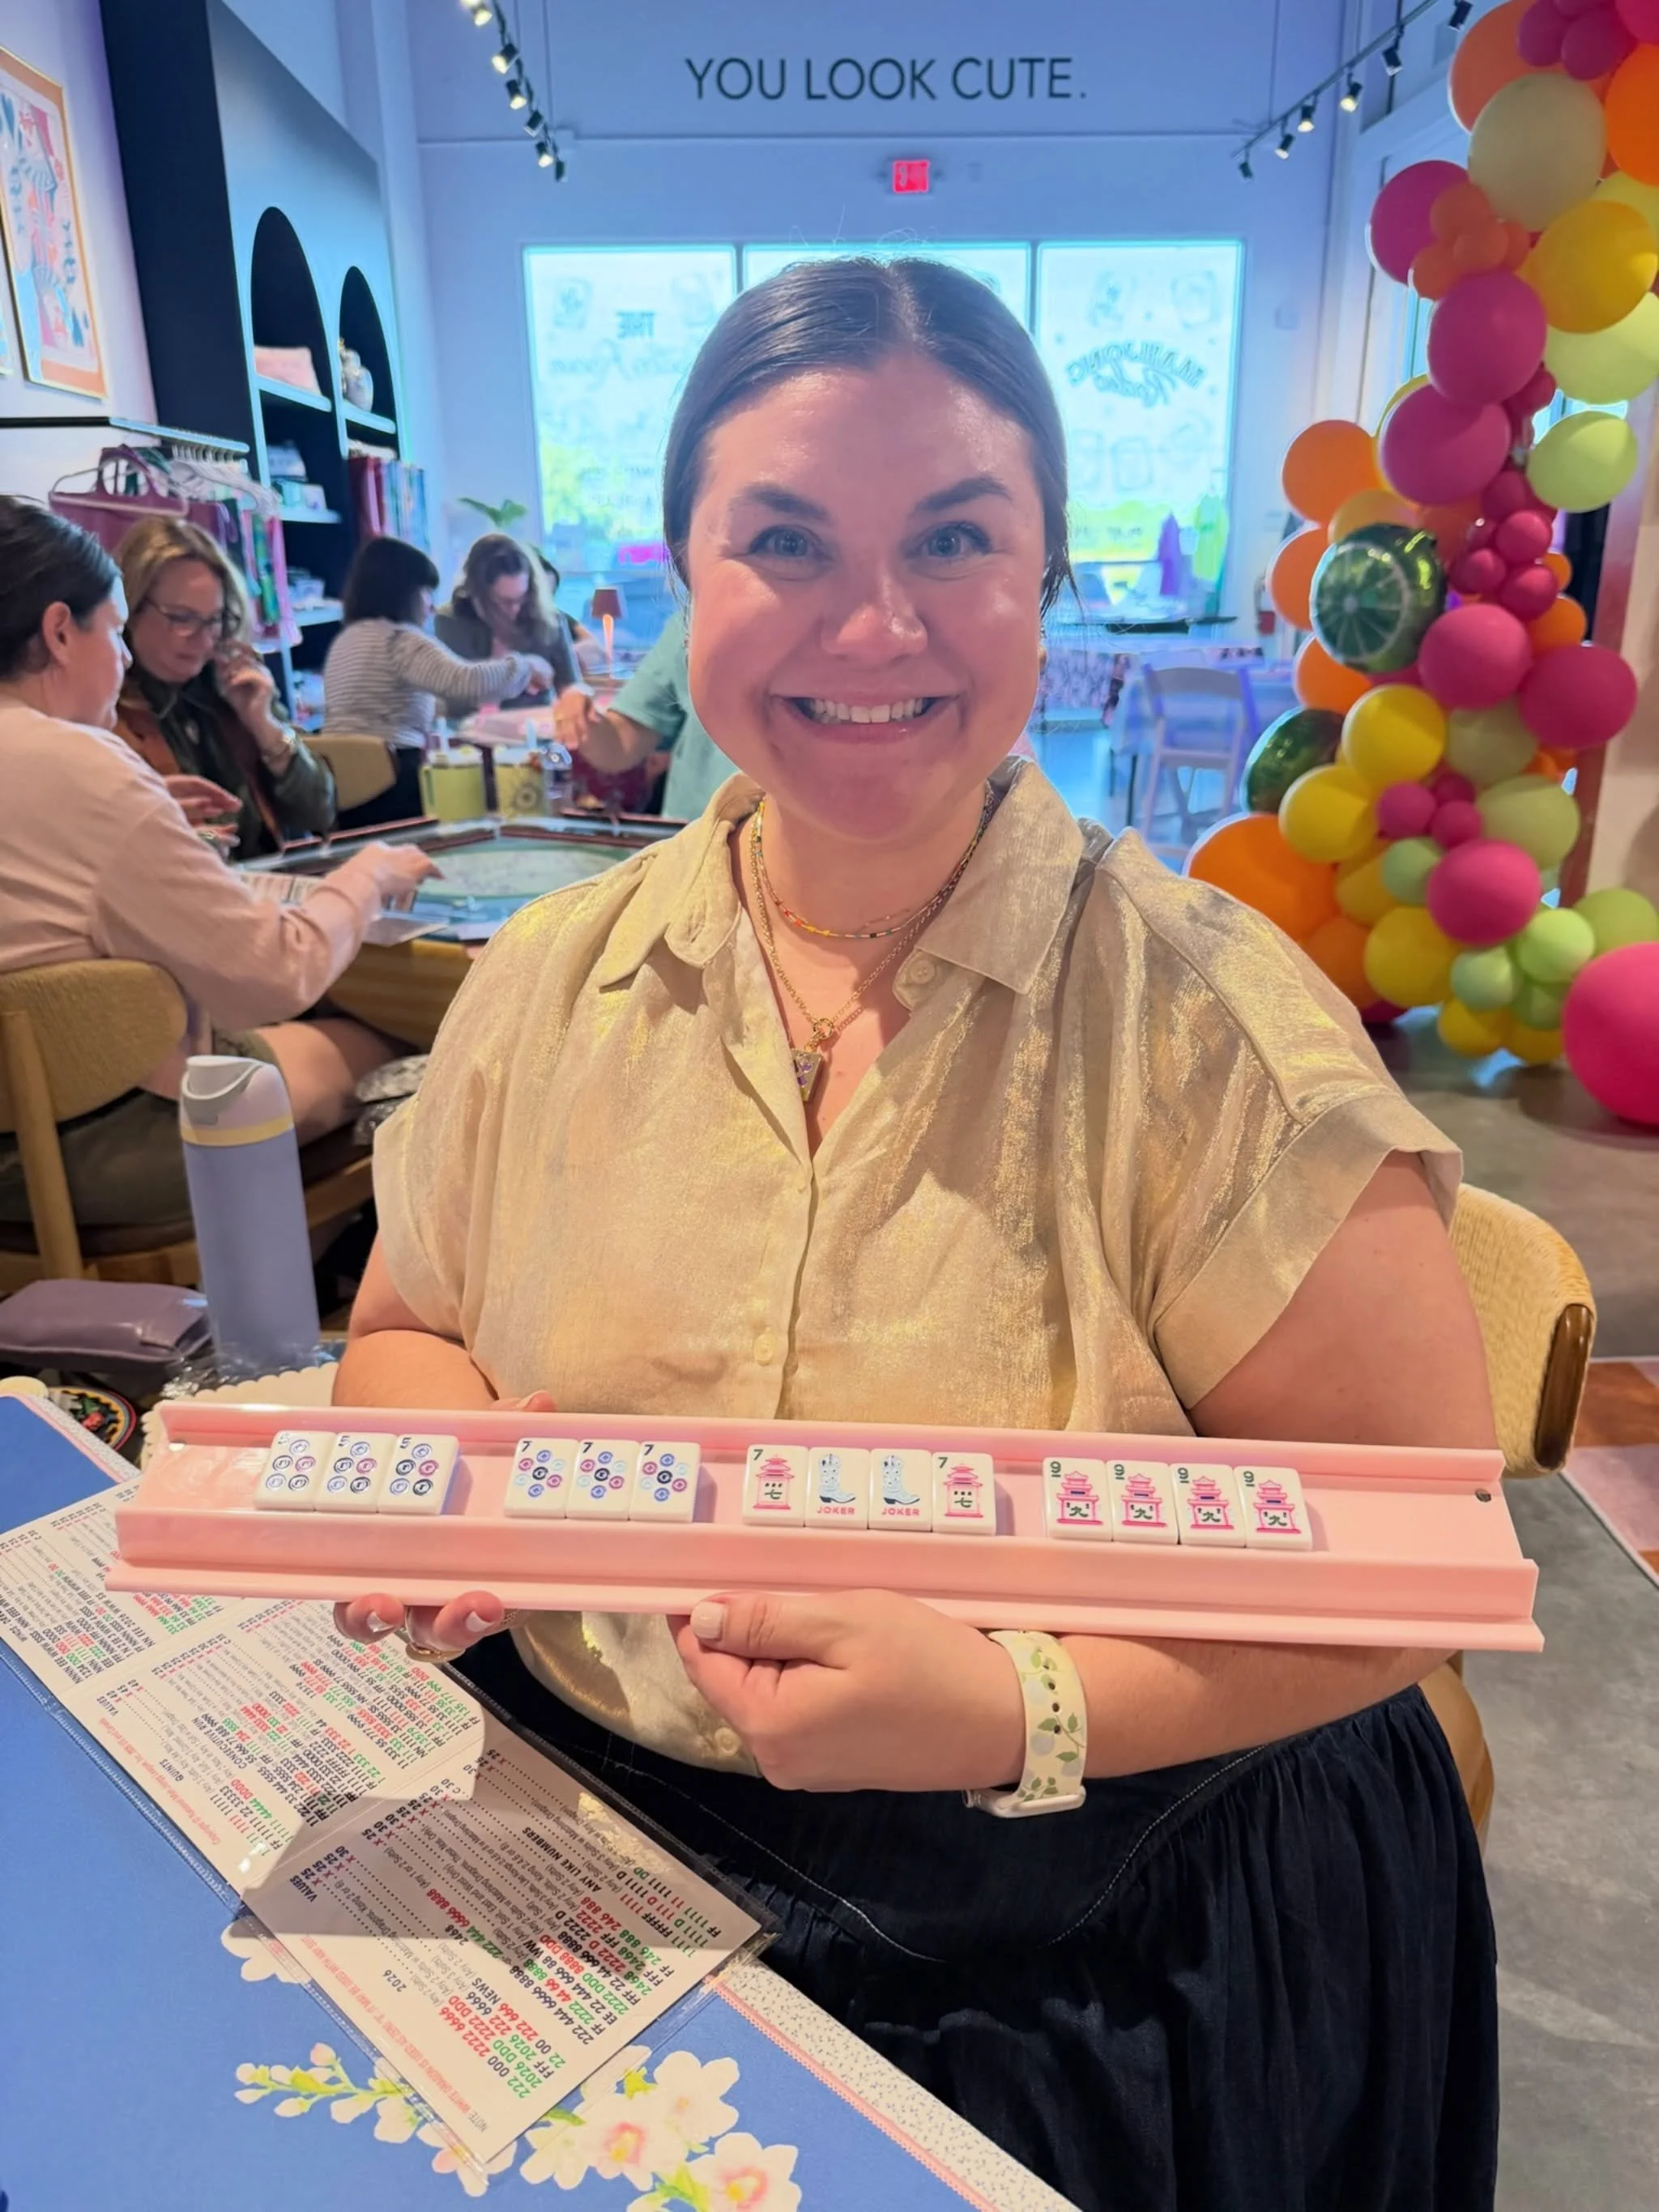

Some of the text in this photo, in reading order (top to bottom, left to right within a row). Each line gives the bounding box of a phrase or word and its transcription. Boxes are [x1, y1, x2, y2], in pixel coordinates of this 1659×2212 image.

[685, 58, 1087, 100] YOU LOOK CUTE.
[278, 1433, 291, 1445] 5
[338, 1435, 350, 1447] 5
[399, 1437, 412, 1449] 5
[521, 1440, 532, 1451] 7
[582, 1442, 594, 1453] 7
[644, 1444, 655, 1455] 7
[753, 1449, 764, 1461] 7
[938, 1456, 949, 1468] 7
[1050, 1461, 1062, 1477] 9
[1114, 1464, 1126, 1480] 9
[1178, 1467, 1190, 1484] 9
[1243, 1470, 1256, 1487] 9
[817, 1507, 855, 1515] JOKER
[881, 1507, 920, 1517] JOKER
[95, 1694, 120, 1716] VALUES
[190, 1716, 248, 1770] CONSECUTIVE RUN
[485, 1748, 501, 1759] 25
[158, 1758, 185, 1783] QUINTS
[462, 1762, 477, 1775] 30
[429, 1784, 445, 1796] 30
[440, 1776, 455, 1789] 30
[256, 1765, 319, 1826] 11 222 33 444 5555
[407, 1798, 422, 1811] 25
[219, 1784, 284, 1850] FF 11111 22 33333
[384, 1812, 400, 1826] 30
[395, 1805, 412, 1818] 25
[360, 1826, 377, 1840] 25
[372, 1820, 388, 1833] 30
[323, 1852, 339, 1865] 25
[334, 1844, 349, 1857] 30
[521, 1825, 602, 1894] ANY LIKE NUMBERS
[301, 1866, 316, 1880] 25
[311, 1859, 327, 1873] 25
[614, 1869, 628, 1880] D
[632, 1865, 650, 1880] DD
[624, 1877, 649, 1898] 1111
[647, 1877, 672, 1898] 1111
[424, 1887, 451, 1910] 8888
[579, 1894, 603, 1915] 888
[618, 1892, 645, 1914] 1111
[645, 1894, 659, 1905] D
[670, 1895, 685, 1908] 11
[444, 1905, 471, 1929] 6666
[553, 1908, 567, 1920] D
[574, 1909, 603, 1934] 2222
[598, 1911, 622, 1932] 246
[655, 1903, 676, 1920] 111
[672, 1916, 685, 1928] D
[683, 1906, 709, 1928] 1111
[288, 1873, 407, 1993] 2026 VALUES
[443, 1923, 469, 1946] 2468
[464, 1924, 487, 1945] 444
[562, 1916, 591, 1941] 2222
[640, 1910, 673, 1938] FFFFFF
[706, 1924, 721, 1937] FF
[537, 1933, 563, 1955] DDD
[556, 1929, 583, 1954] 8888
[586, 1938, 601, 1950] D
[599, 1930, 621, 1949] FFF
[617, 1928, 642, 1949] 888
[670, 1935, 697, 1958] 1111
[682, 1925, 709, 1947] 1111
[480, 1938, 504, 1959] 222
[522, 1937, 546, 1958] WW
[616, 1945, 646, 1971] 2468
[637, 1945, 662, 1966] 246
[522, 1957, 548, 1981] 8888
[540, 1954, 558, 1970] 88
[557, 1950, 585, 1975] 8888
[577, 1949, 601, 1969] 666
[596, 1946, 626, 1973] 2222
[507, 1964, 535, 1989] 8888
[552, 1965, 576, 1986] 666
[595, 1964, 613, 1980] 44
[642, 1967, 663, 1986] FFF
[658, 1963, 675, 1977] FF
[470, 1975, 501, 2005] NEWS
[543, 1976, 561, 1993] 66
[570, 1981, 594, 2002] 444
[580, 1971, 606, 1994] DDD
[608, 1975, 626, 1992] 22
[621, 1969, 652, 1996] 2468
[446, 1993, 473, 2018] DDD
[463, 1989, 493, 2018] 6666
[530, 1985, 557, 2010] 6666
[555, 1988, 573, 2004] 44
[588, 1998, 607, 2014] 22
[601, 1990, 629, 2016] 2222
[621, 1988, 641, 2005] FFF
[437, 2005, 467, 2034] 6666
[496, 2001, 520, 2023] 666
[552, 2006, 576, 2028] 444
[567, 2000, 595, 2026] 2222
[601, 2010, 618, 2025] EE
[467, 2014, 497, 2042] 2222
[487, 2013, 513, 2036] 222
[514, 2018, 539, 2042] 222
[570, 2023, 595, 2045] 222
[590, 2021, 606, 2035] FF
[460, 2028, 491, 2058] 2222
[490, 2037, 518, 2064] DDD
[506, 2032, 538, 2061] 2026
[533, 2037, 553, 2056] 00
[485, 2053, 511, 2078] 000
[531, 2057, 555, 2079] FFF
[547, 2051, 567, 2069] 22
[512, 2059, 544, 2089] 2026
[505, 2074, 531, 2099] 222
